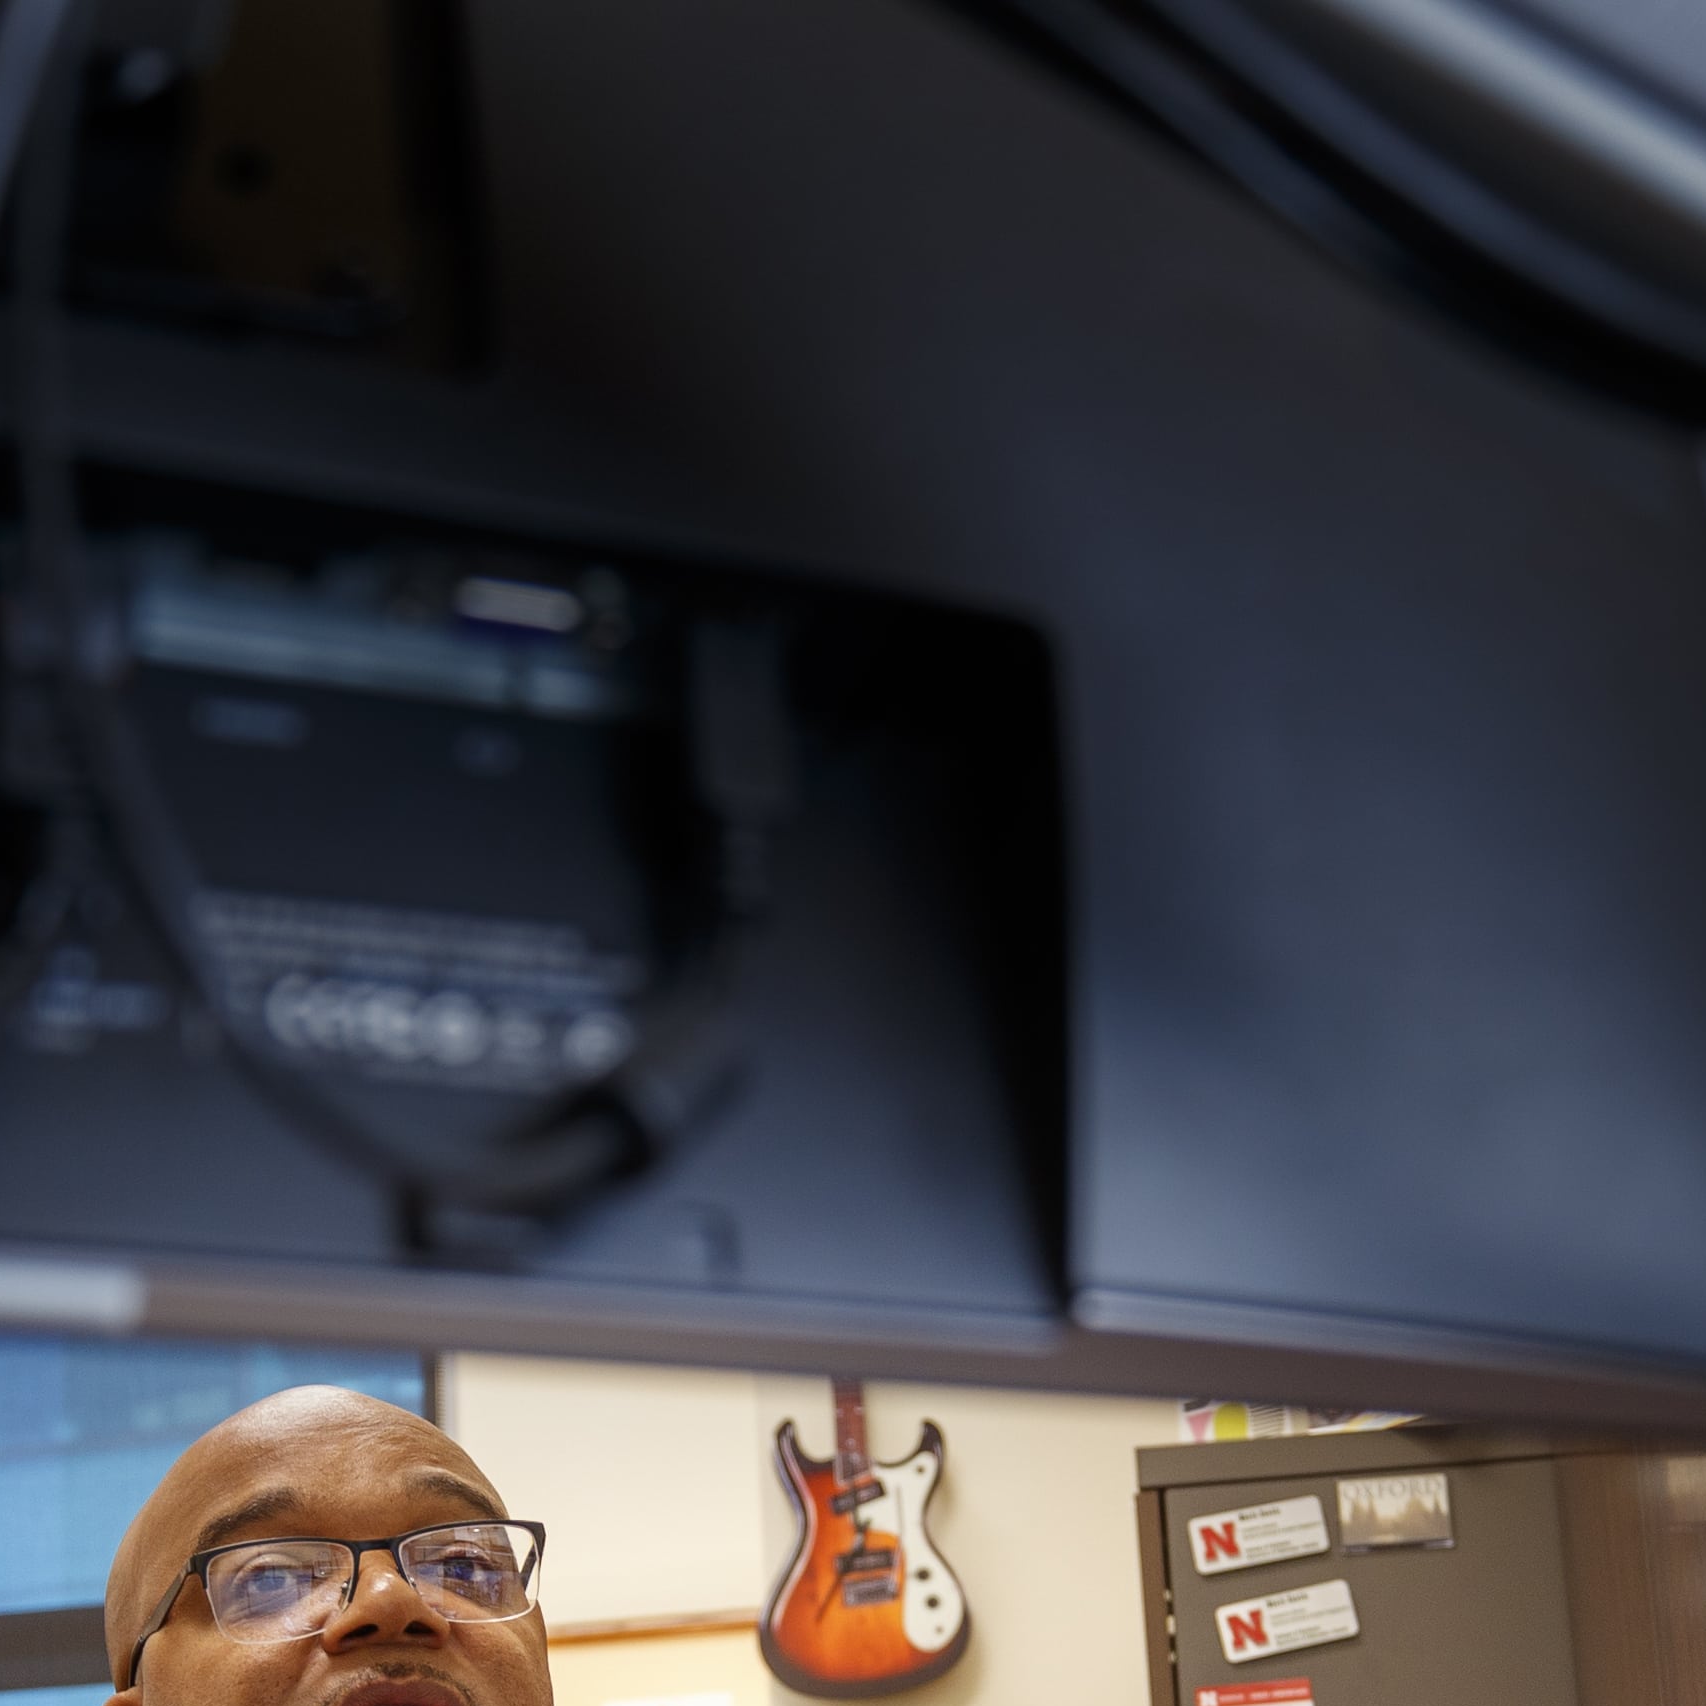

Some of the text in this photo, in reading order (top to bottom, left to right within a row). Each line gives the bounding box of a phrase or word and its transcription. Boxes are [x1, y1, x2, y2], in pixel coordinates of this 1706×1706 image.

[1342, 1477, 1442, 1501] OXFORD
[1199, 1521, 1240, 1562] N
[1227, 1609, 1269, 1651] N
